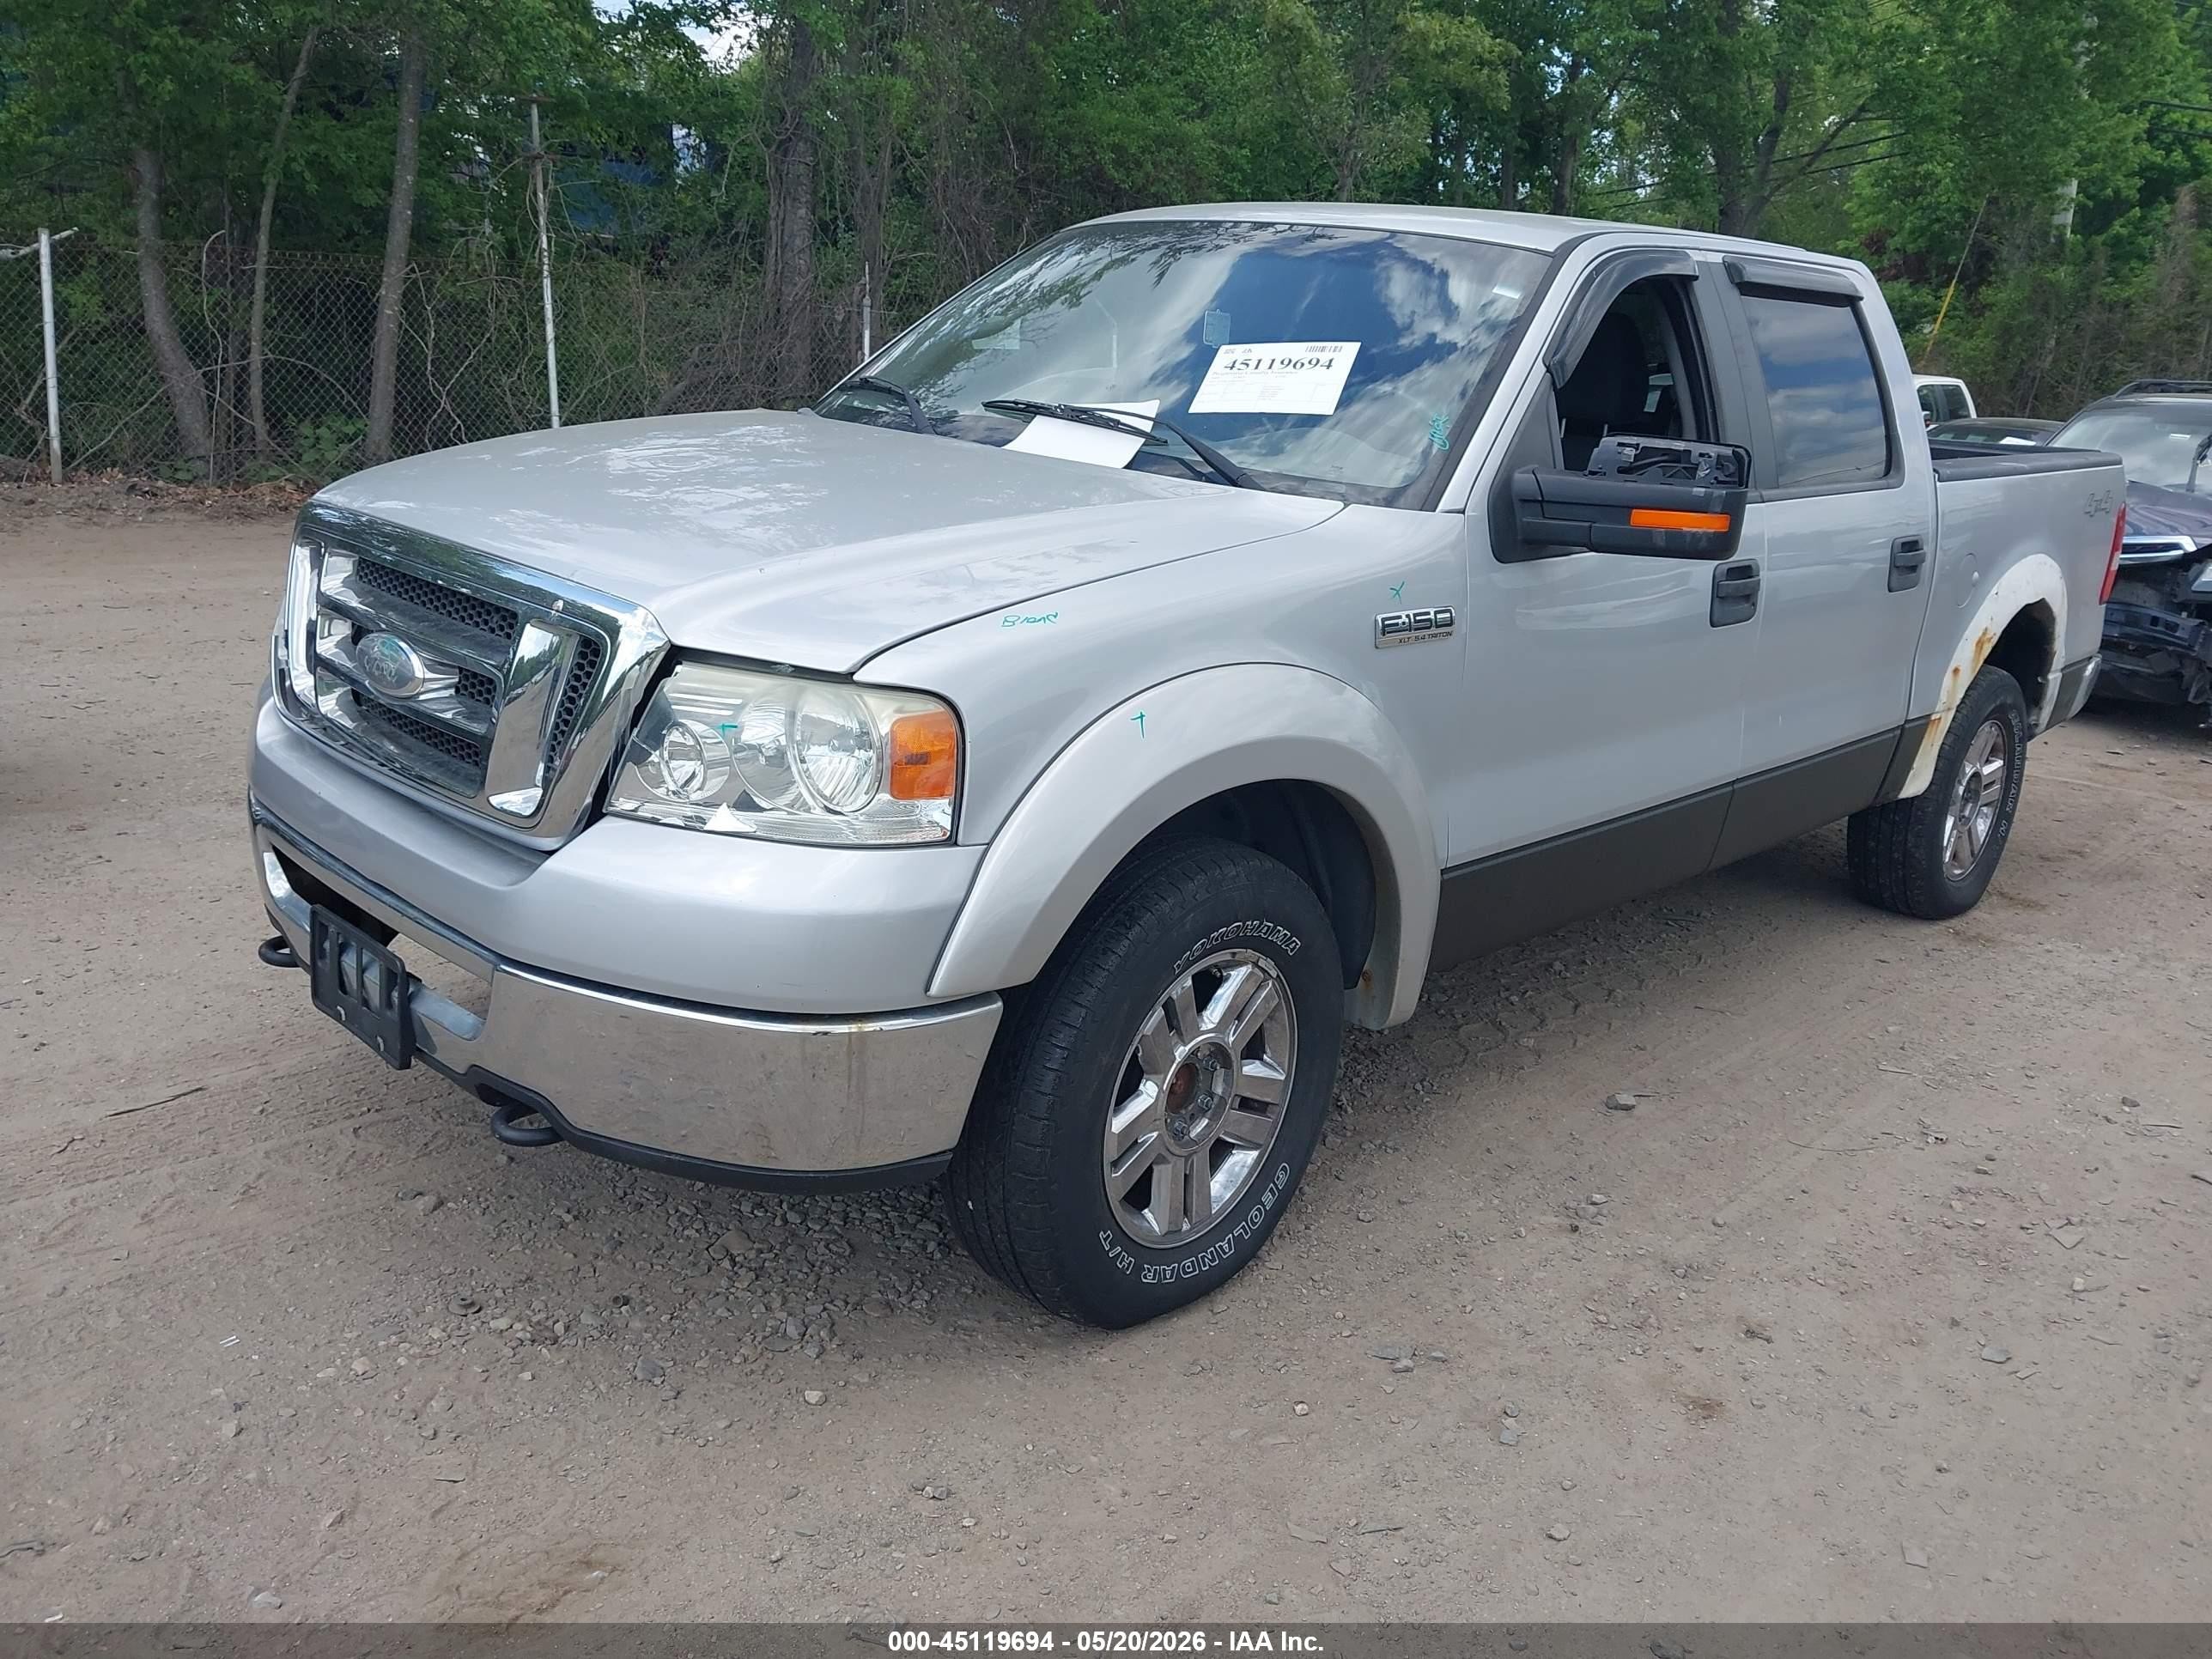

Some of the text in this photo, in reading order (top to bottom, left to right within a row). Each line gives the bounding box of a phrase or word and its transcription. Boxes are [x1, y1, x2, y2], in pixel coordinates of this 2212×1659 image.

[1224, 356, 1334, 371] 45119694
[2083, 489, 2113, 518] 4x4
[1426, 630, 1453, 640] TRITON
[1173, 920, 1301, 975] YOKOHAMA
[1099, 1162, 1291, 1284] GEOLANDAR H/T
